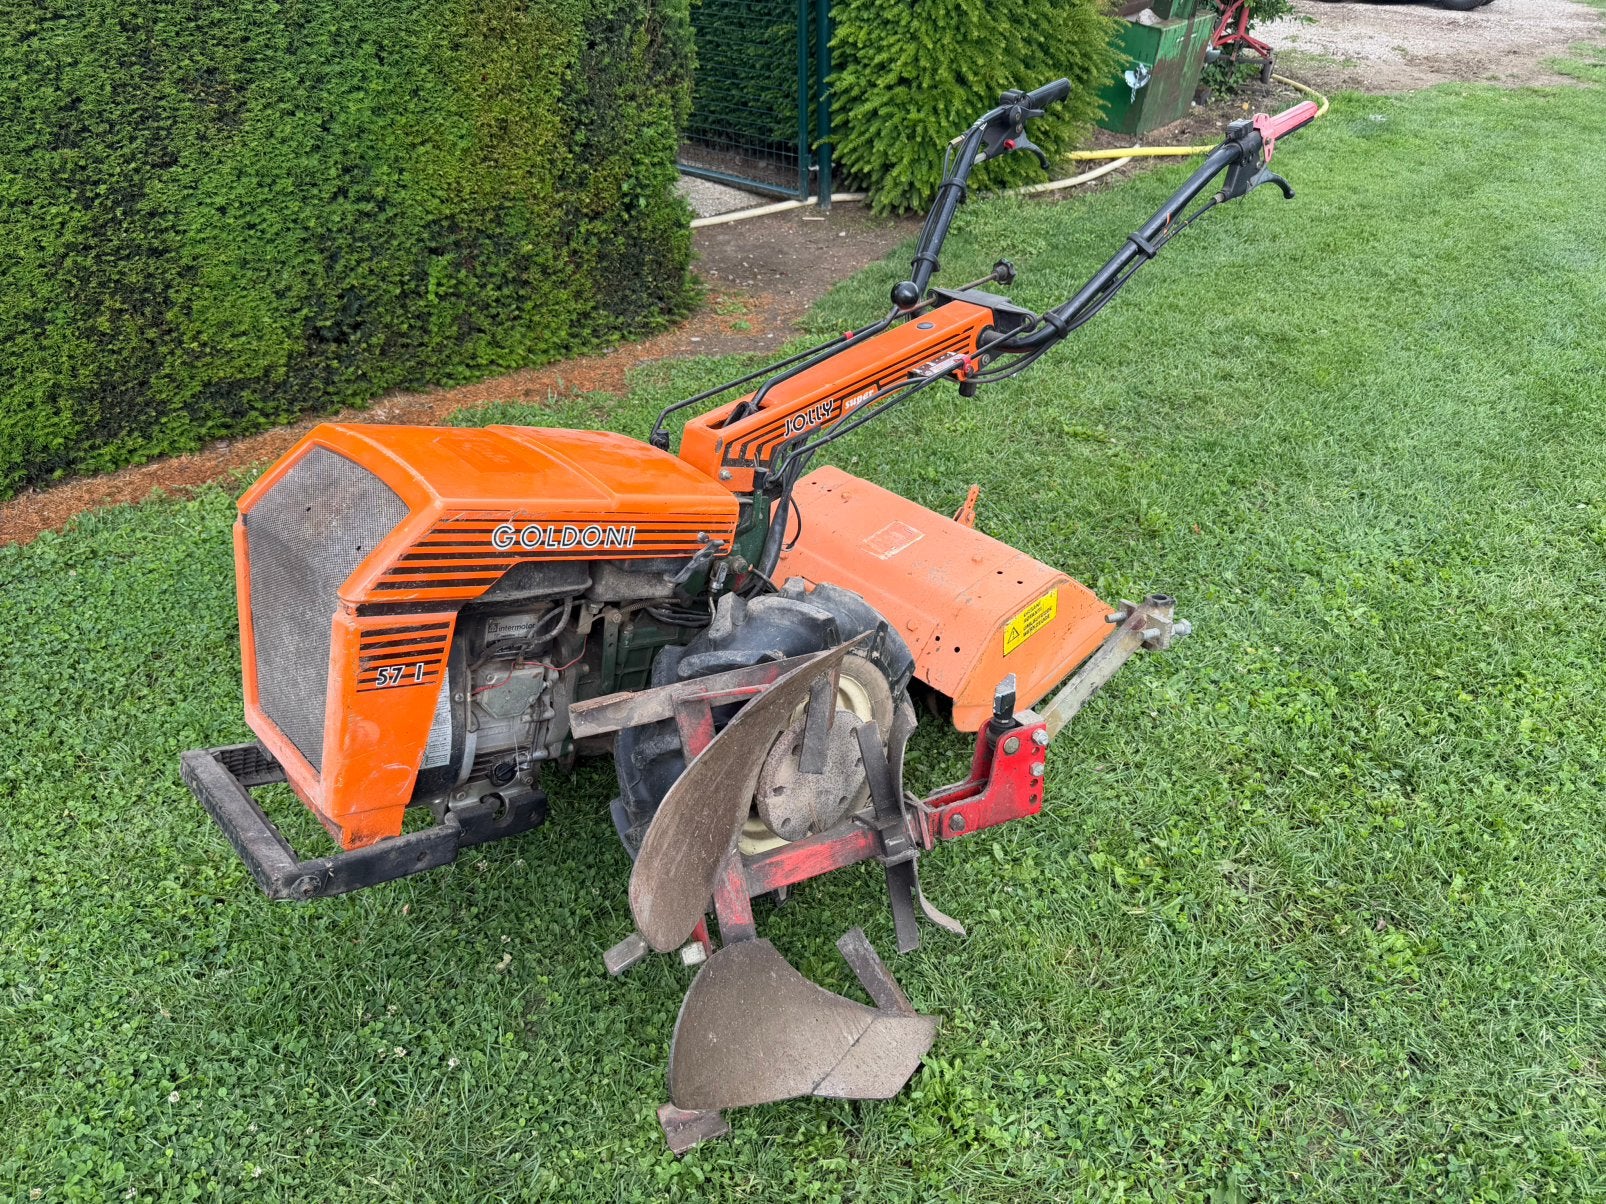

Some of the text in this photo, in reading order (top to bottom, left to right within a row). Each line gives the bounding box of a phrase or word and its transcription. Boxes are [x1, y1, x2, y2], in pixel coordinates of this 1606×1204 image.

[784, 389, 874, 439] JOLLY super
[492, 524, 637, 550] GOLDONI
[376, 666, 406, 687] 57
